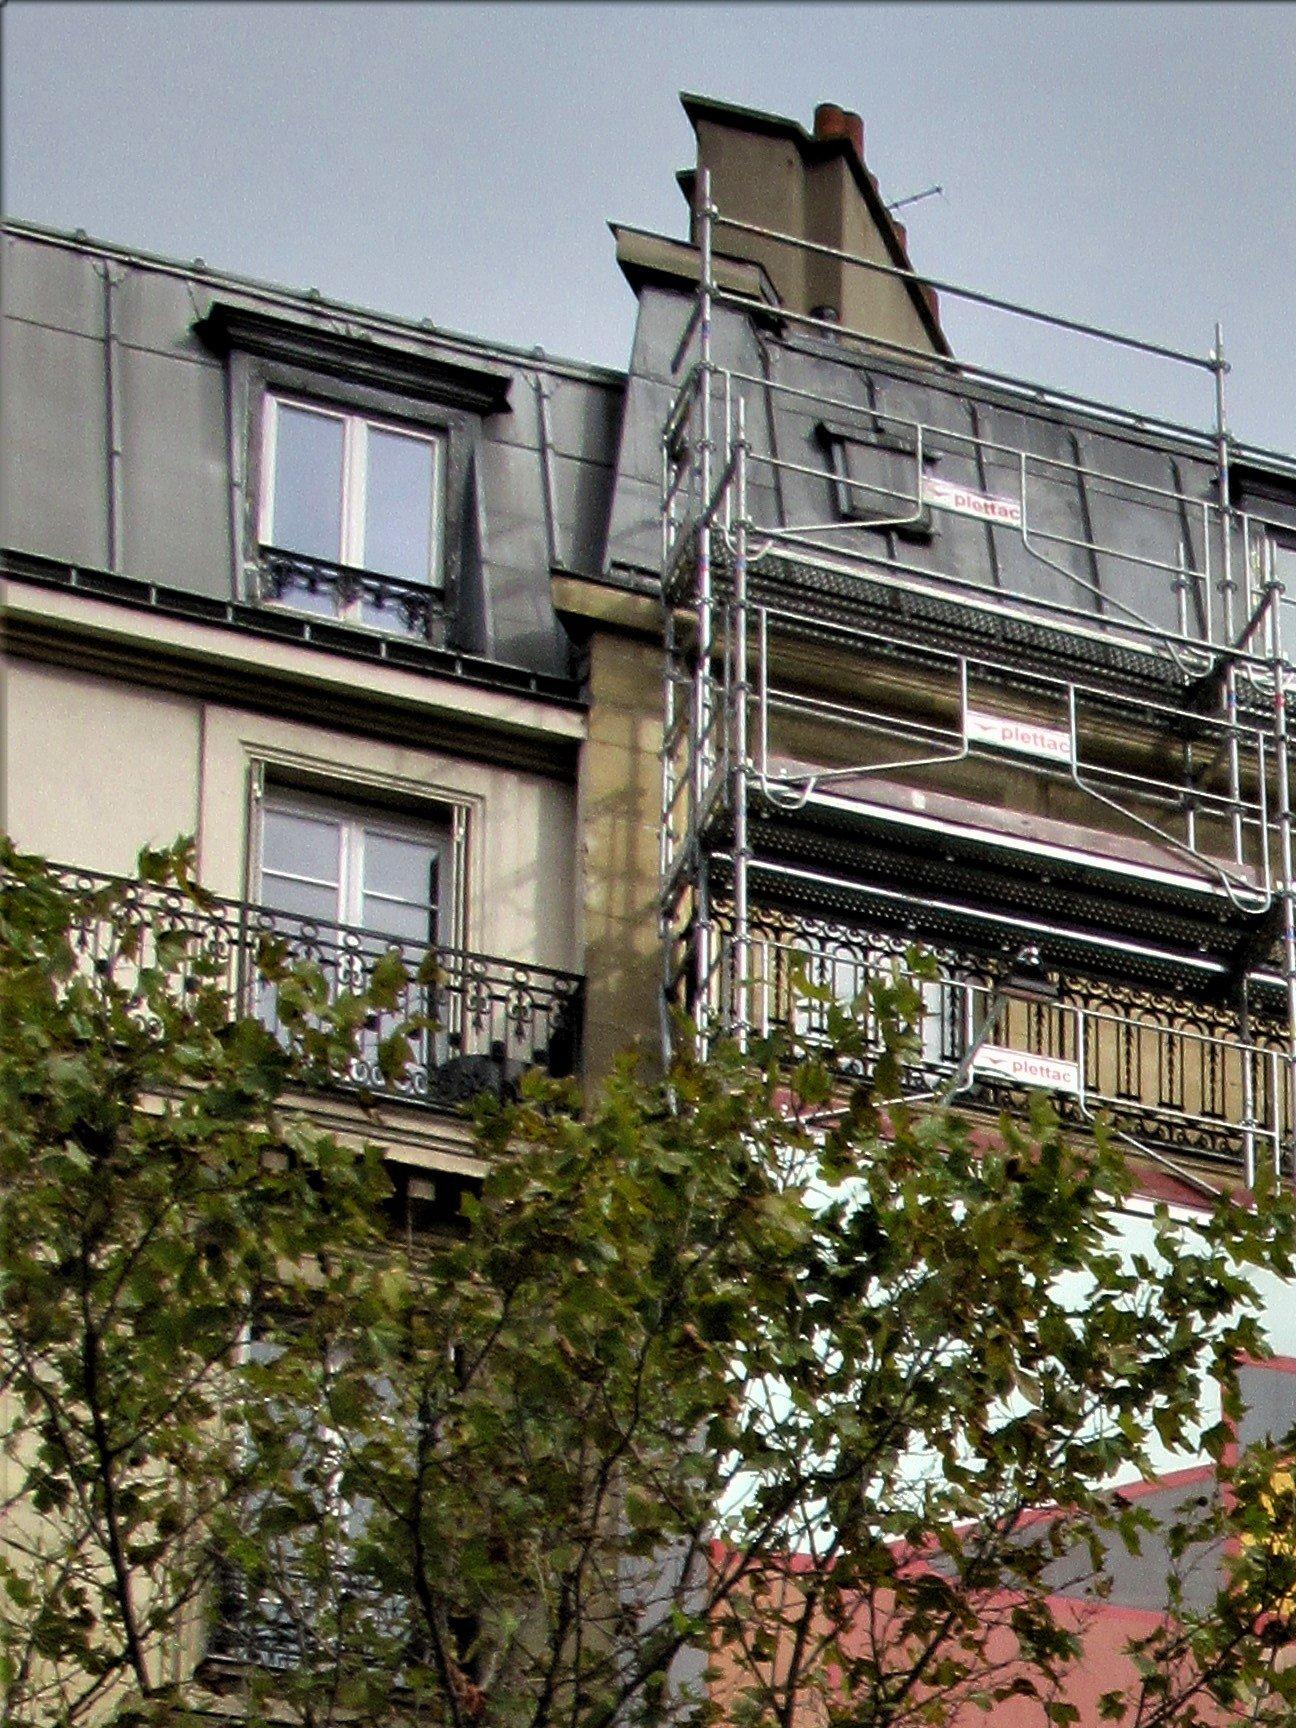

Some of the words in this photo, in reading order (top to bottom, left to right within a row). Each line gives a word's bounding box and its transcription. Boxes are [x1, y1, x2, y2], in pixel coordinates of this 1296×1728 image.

[954, 491, 1020, 519] plettac
[1001, 725, 1071, 754] plettac
[1012, 1060, 1072, 1083] plettac
